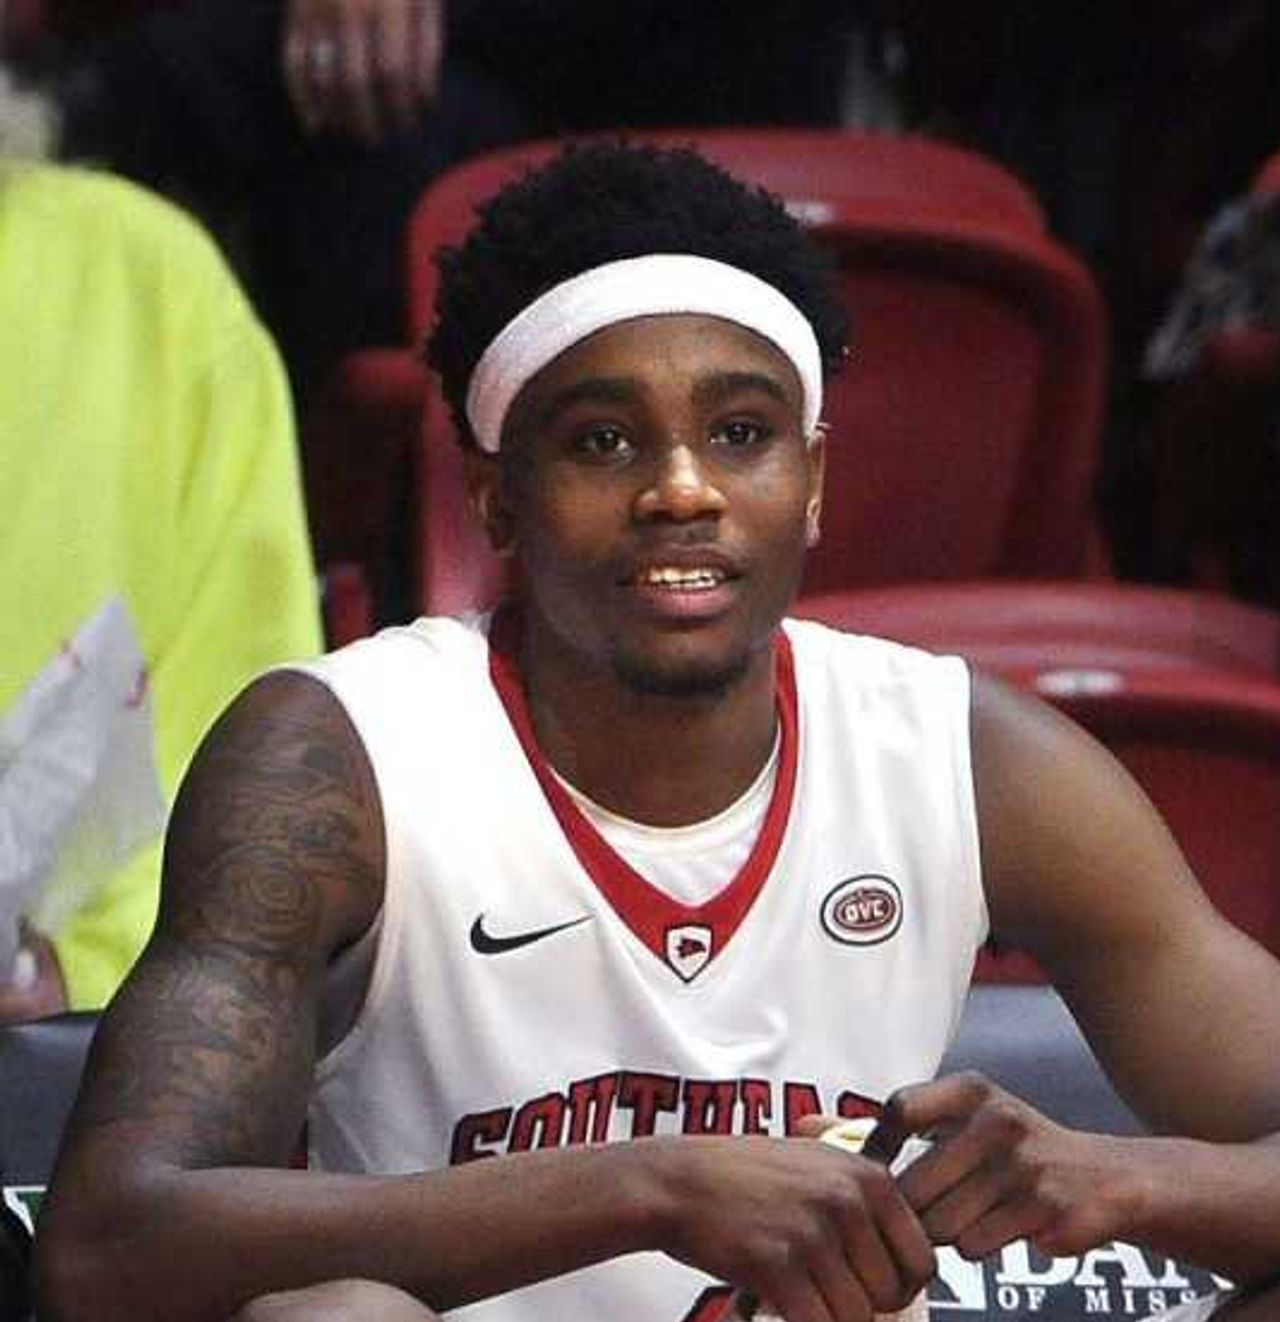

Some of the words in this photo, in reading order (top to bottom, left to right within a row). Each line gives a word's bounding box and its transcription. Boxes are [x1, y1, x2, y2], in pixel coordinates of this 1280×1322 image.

[844, 899, 886, 922] OVC
[998, 1286, 1047, 1312] OF
[1085, 1288, 1200, 1313] MISS
